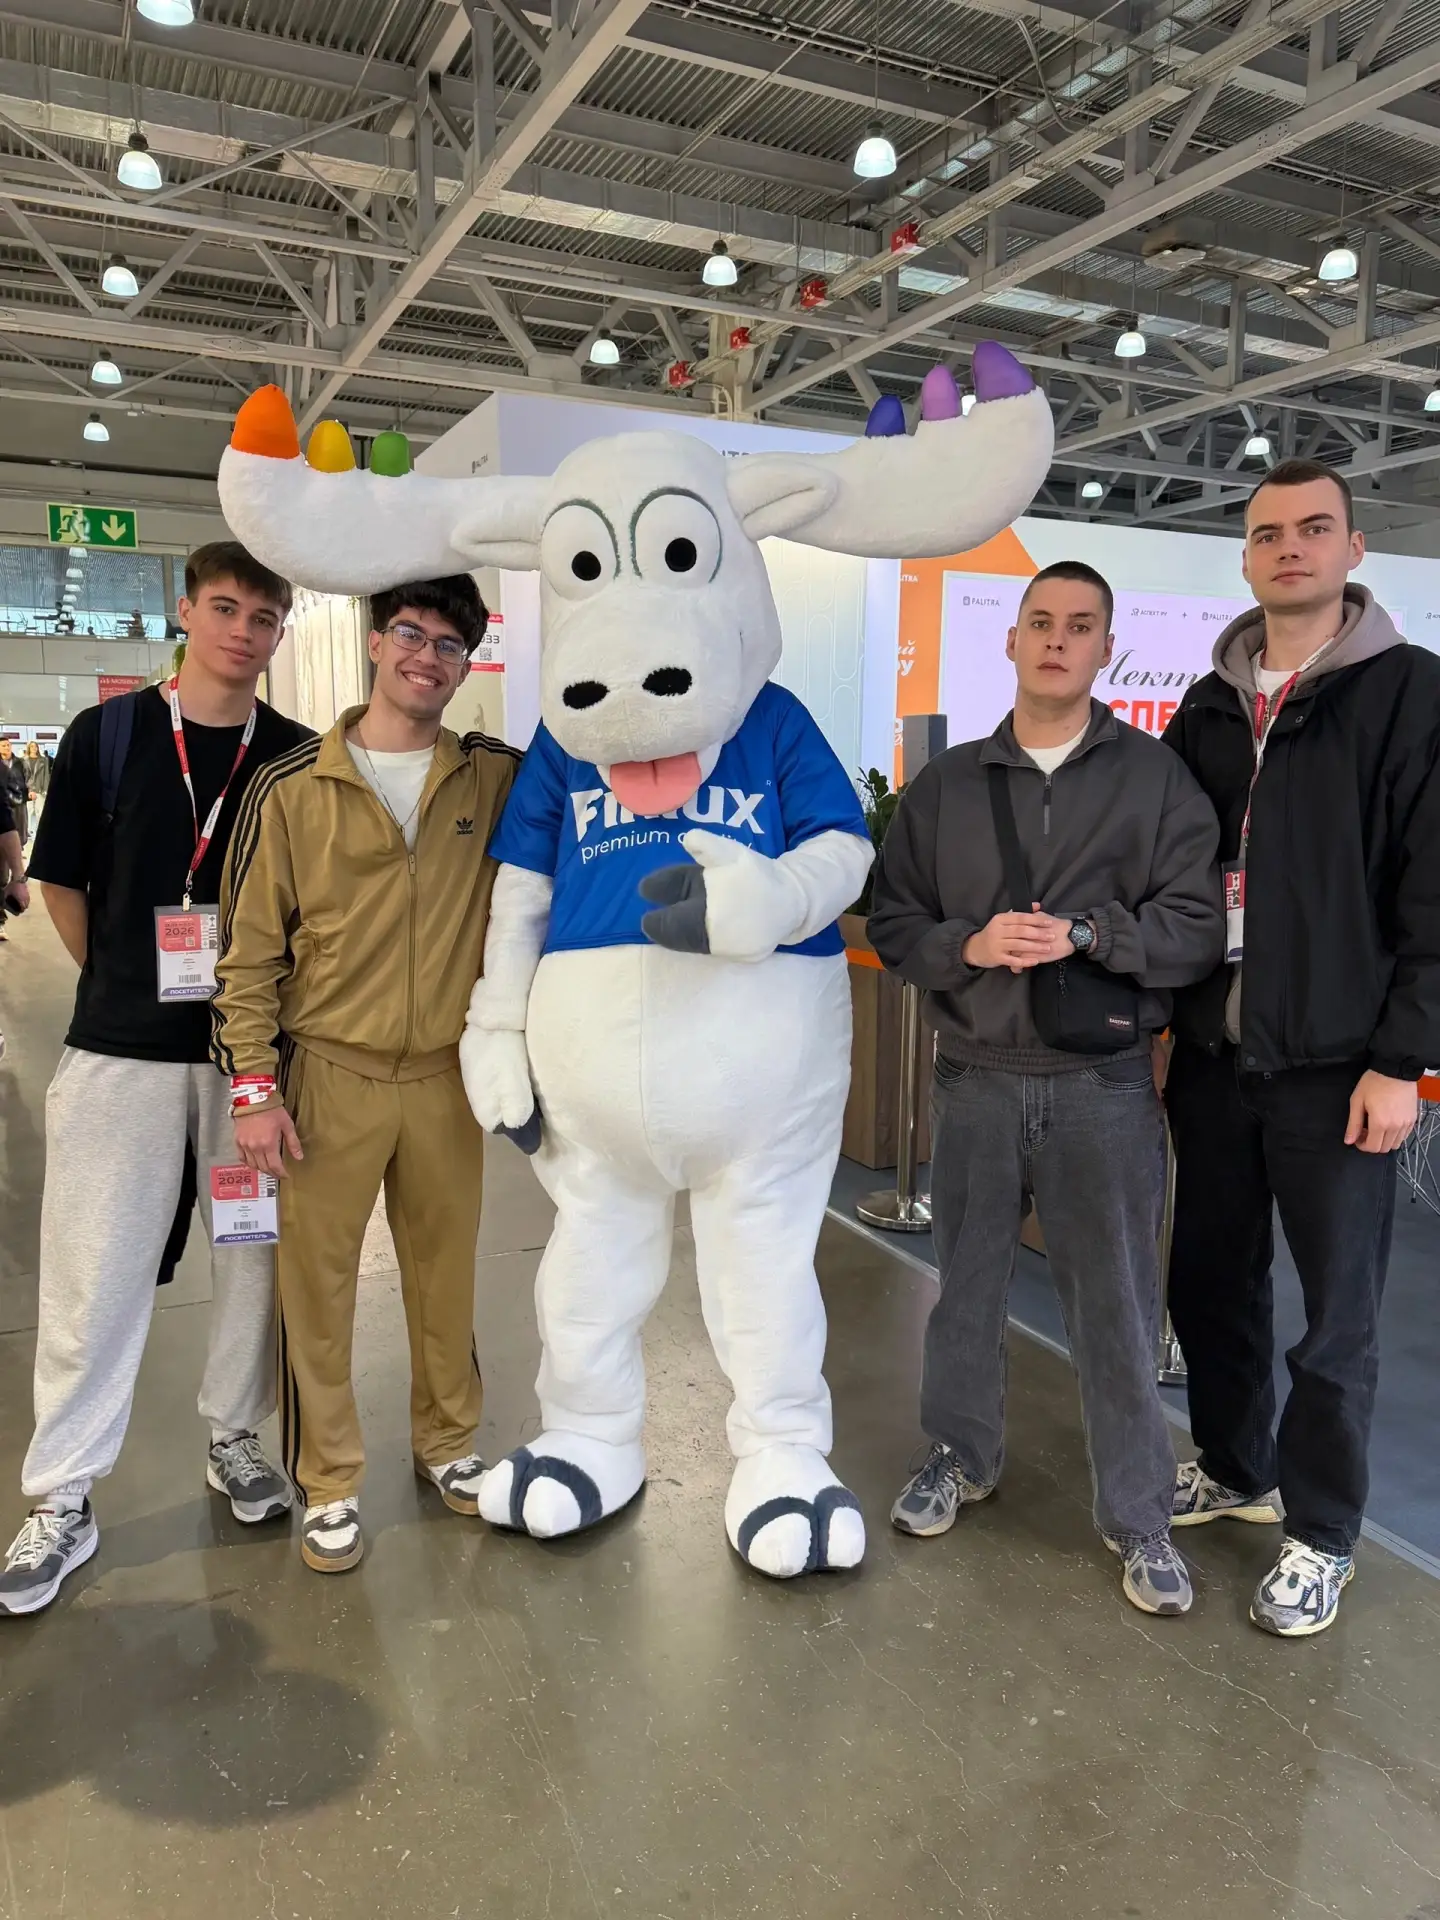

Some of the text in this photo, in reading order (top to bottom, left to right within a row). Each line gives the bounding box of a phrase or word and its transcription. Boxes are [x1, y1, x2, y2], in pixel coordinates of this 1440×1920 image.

[971, 597, 1000, 606] PALITRA
[581, 830, 670, 865] premium
[165, 926, 195, 936] 2026
[218, 1175, 252, 1185] 2026
